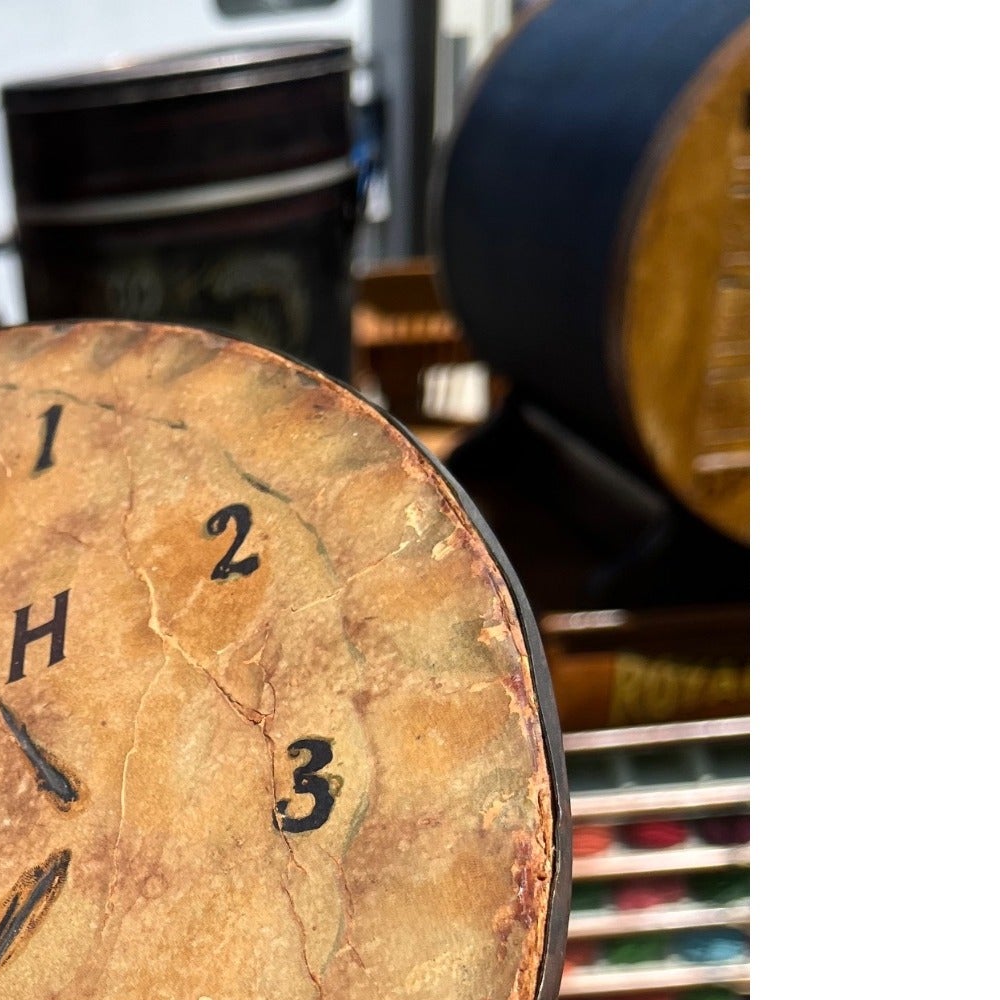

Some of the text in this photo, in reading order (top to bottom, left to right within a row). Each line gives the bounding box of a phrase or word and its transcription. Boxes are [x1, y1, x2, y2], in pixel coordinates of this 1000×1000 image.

[30, 404, 63, 478] 1
[206, 502, 260, 580] 2
[272, 737, 339, 833] 3
